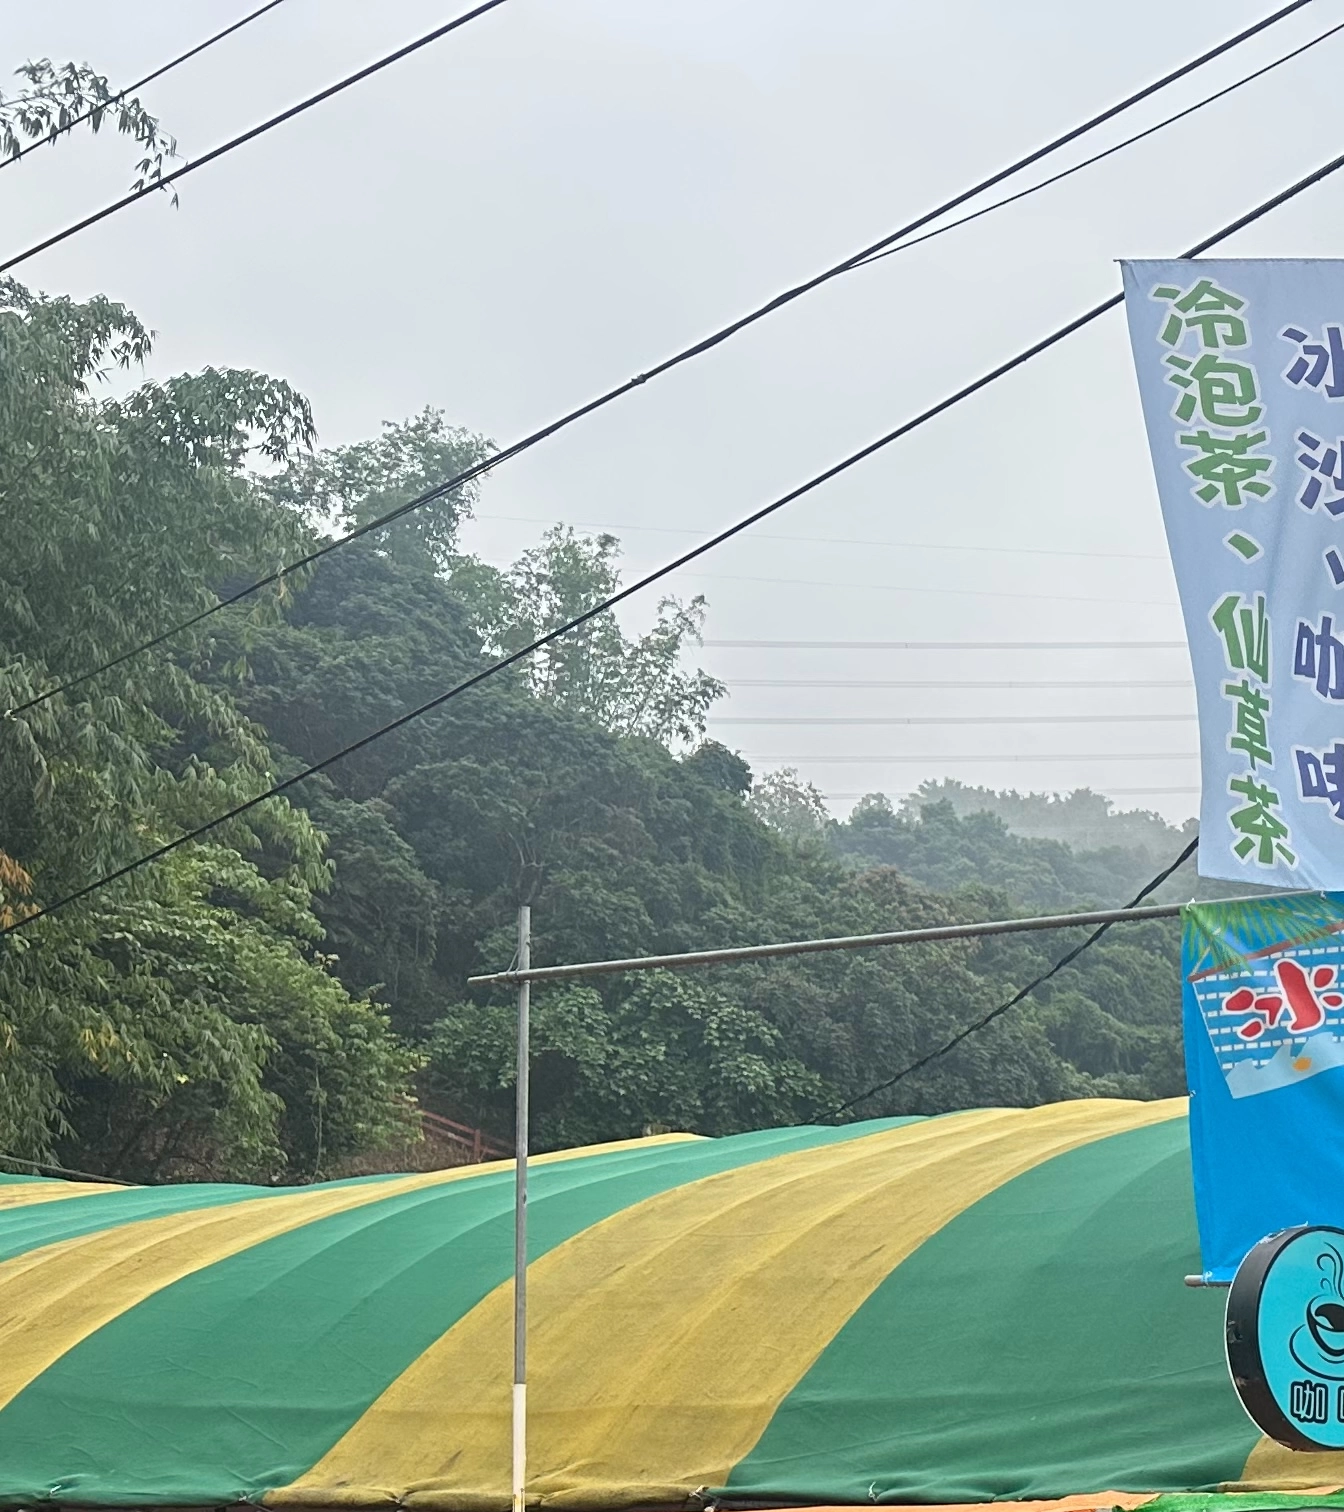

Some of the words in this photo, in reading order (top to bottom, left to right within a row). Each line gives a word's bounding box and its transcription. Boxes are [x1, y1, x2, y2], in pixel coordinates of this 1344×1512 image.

[1153, 281, 1294, 865] 冷泡茶、仙草茶
[1223, 959, 1344, 1040] 冰
